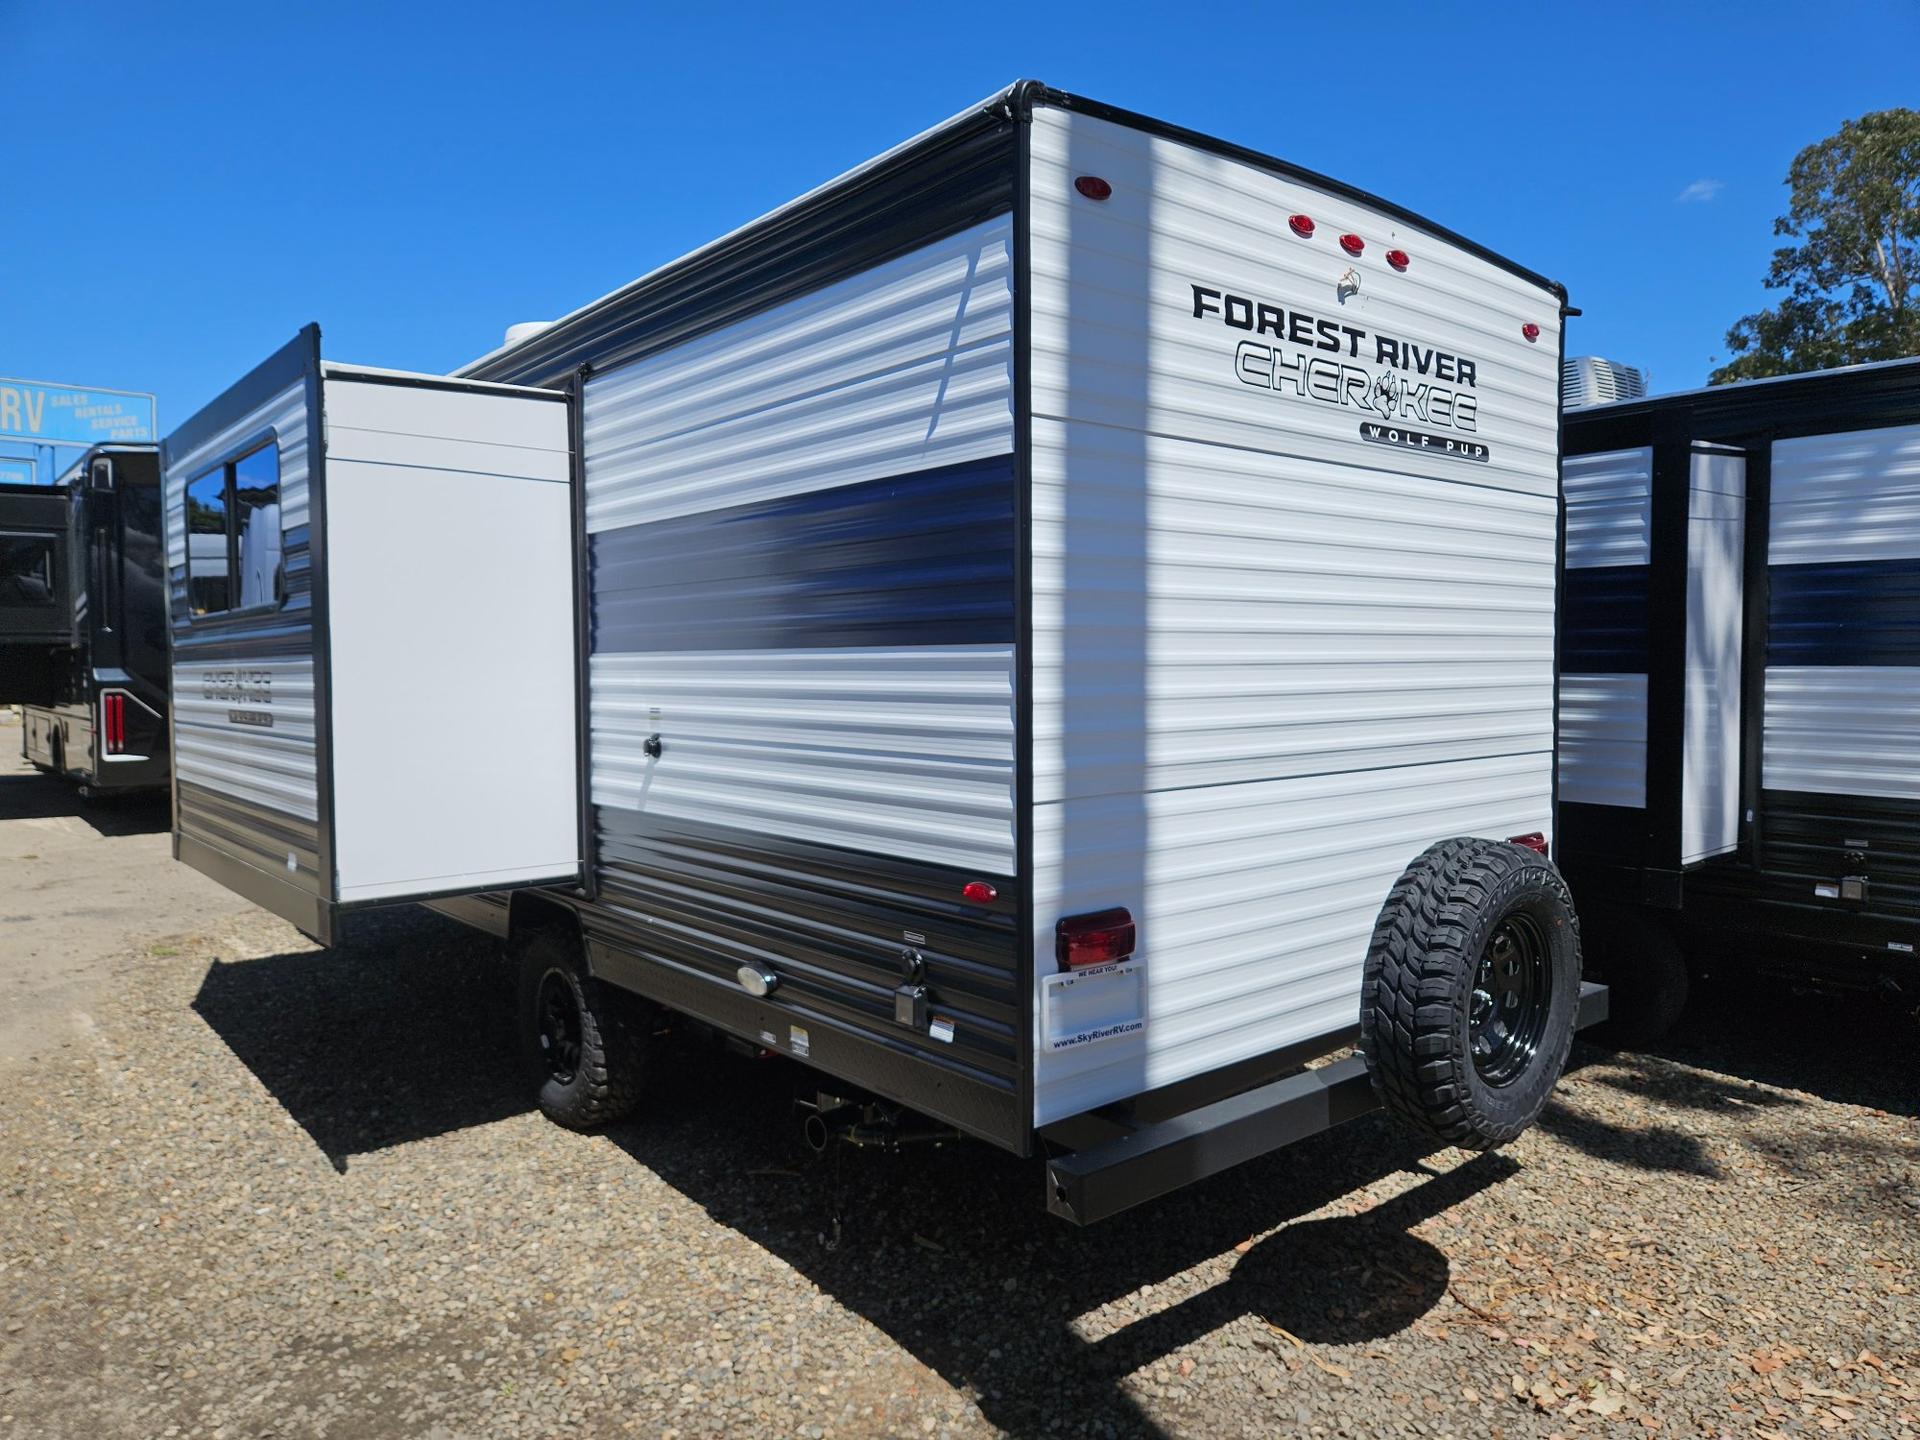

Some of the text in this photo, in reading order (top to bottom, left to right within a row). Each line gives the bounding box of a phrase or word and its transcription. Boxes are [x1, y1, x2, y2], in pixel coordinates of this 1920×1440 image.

[1190, 284, 1477, 388] FOREST RIVER
[1369, 425, 1483, 458] WOLF PUP
[1053, 1022, 1143, 1049] www.SkyRiverRV.com
